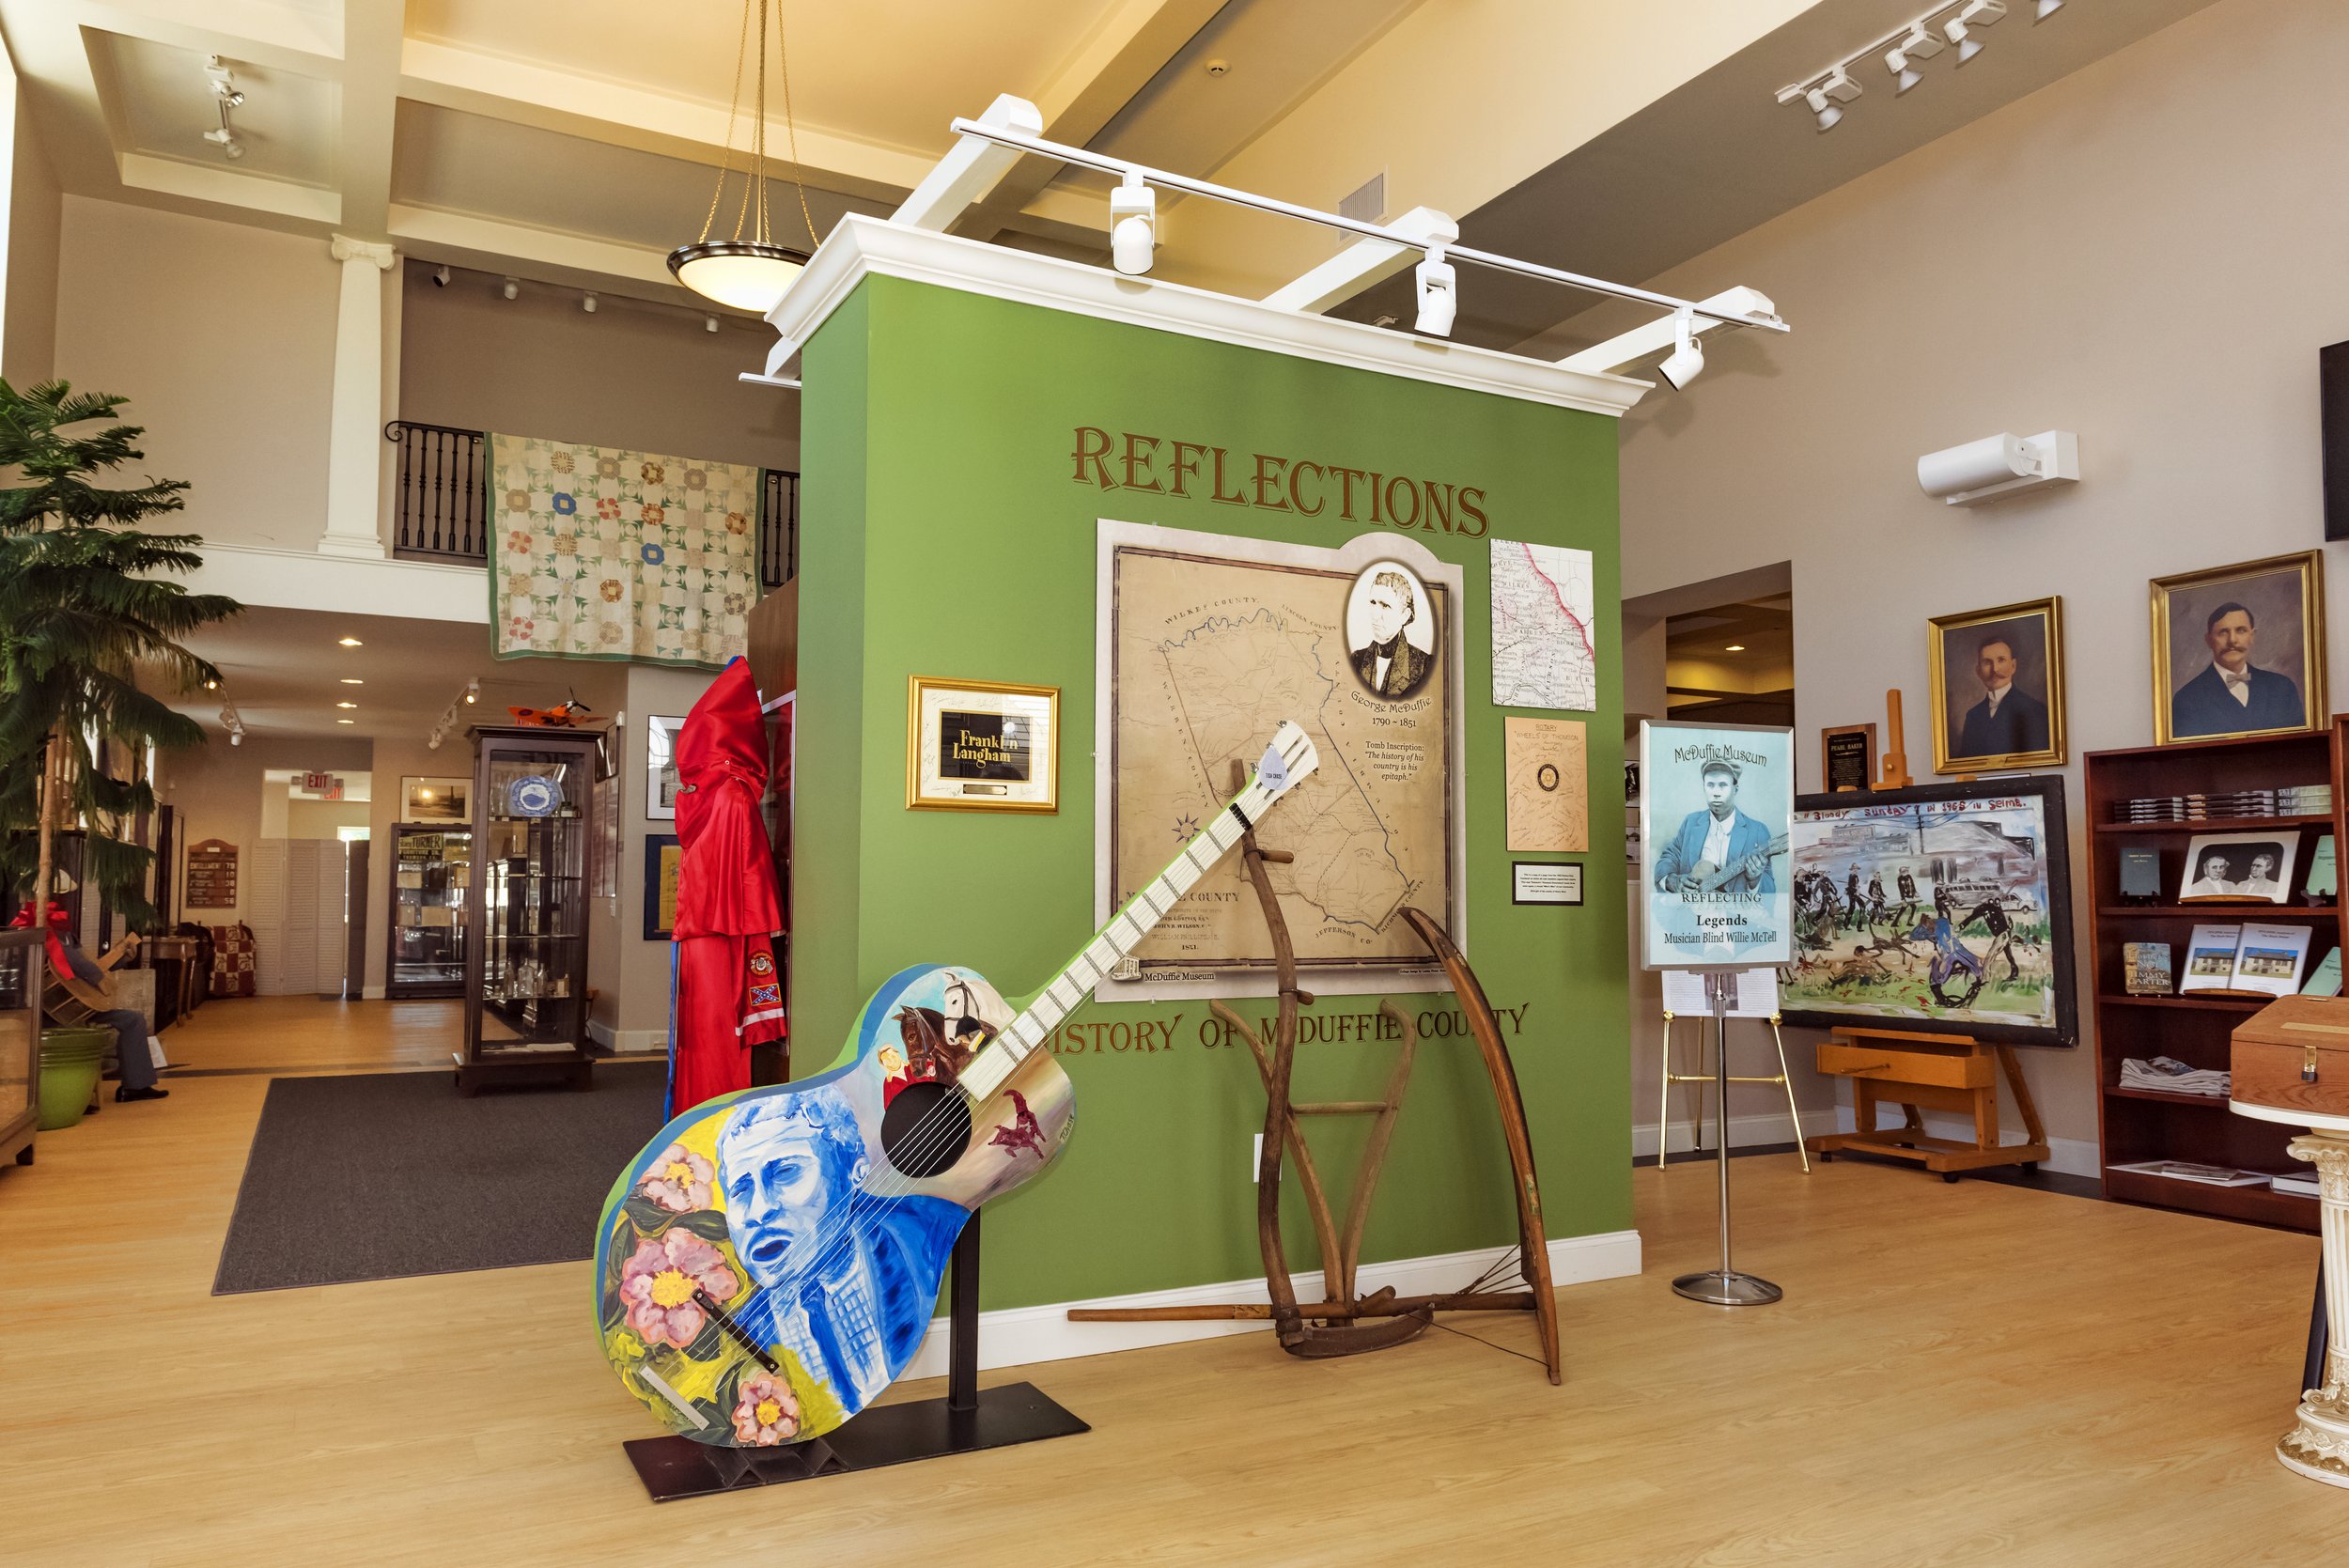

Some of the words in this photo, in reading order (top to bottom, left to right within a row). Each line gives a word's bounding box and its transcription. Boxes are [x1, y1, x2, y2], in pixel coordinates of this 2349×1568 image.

[1070, 426, 1490, 540] REFLECTIONS
[1350, 691, 1387, 713] George
[1389, 697, 1432, 714] McDuffie
[1372, 717, 1391, 726] 1790
[1399, 718, 1417, 729] 1851
[958, 729, 1019, 750] Frankln
[1386, 742, 1424, 753] Inscription:
[952, 742, 1012, 768] Langham
[1364, 751, 1380, 759] "The
[1380, 752, 1406, 762] history
[1406, 752, 1415, 762] of
[1414, 753, 1424, 762] his
[1674, 743, 1722, 763] McDuffie
[1722, 743, 1767, 767] Museum
[1373, 763, 1400, 772] country
[1400, 762, 1408, 770] is
[1408, 763, 1419, 771] his
[308, 774, 328, 788] EXIT
[1381, 772, 1412, 783] epitaph."
[1941, 800, 1967, 812] 1965
[412, 834, 441, 849] TURNER
[1190, 892, 1240, 902] COUNTY
[1681, 893, 1762, 903] REFLECTING
[1696, 914, 1748, 929] Legends
[1315, 927, 1357, 939] JEFFERSON
[1664, 932, 1701, 944] Musician
[1703, 932, 1725, 943] Blind
[1726, 931, 1750, 943] Willie
[1750, 930, 1777, 943] McTell
[1144, 972, 1181, 982] McDuffie
[1181, 971, 1215, 981] Museum
[2127, 978, 2171, 986] CARTER
[1045, 1013, 1185, 1055] ISTORY
[1260, 1013, 1404, 1046] MDUFFIE
[1416, 1001, 1531, 1040] COUTY
